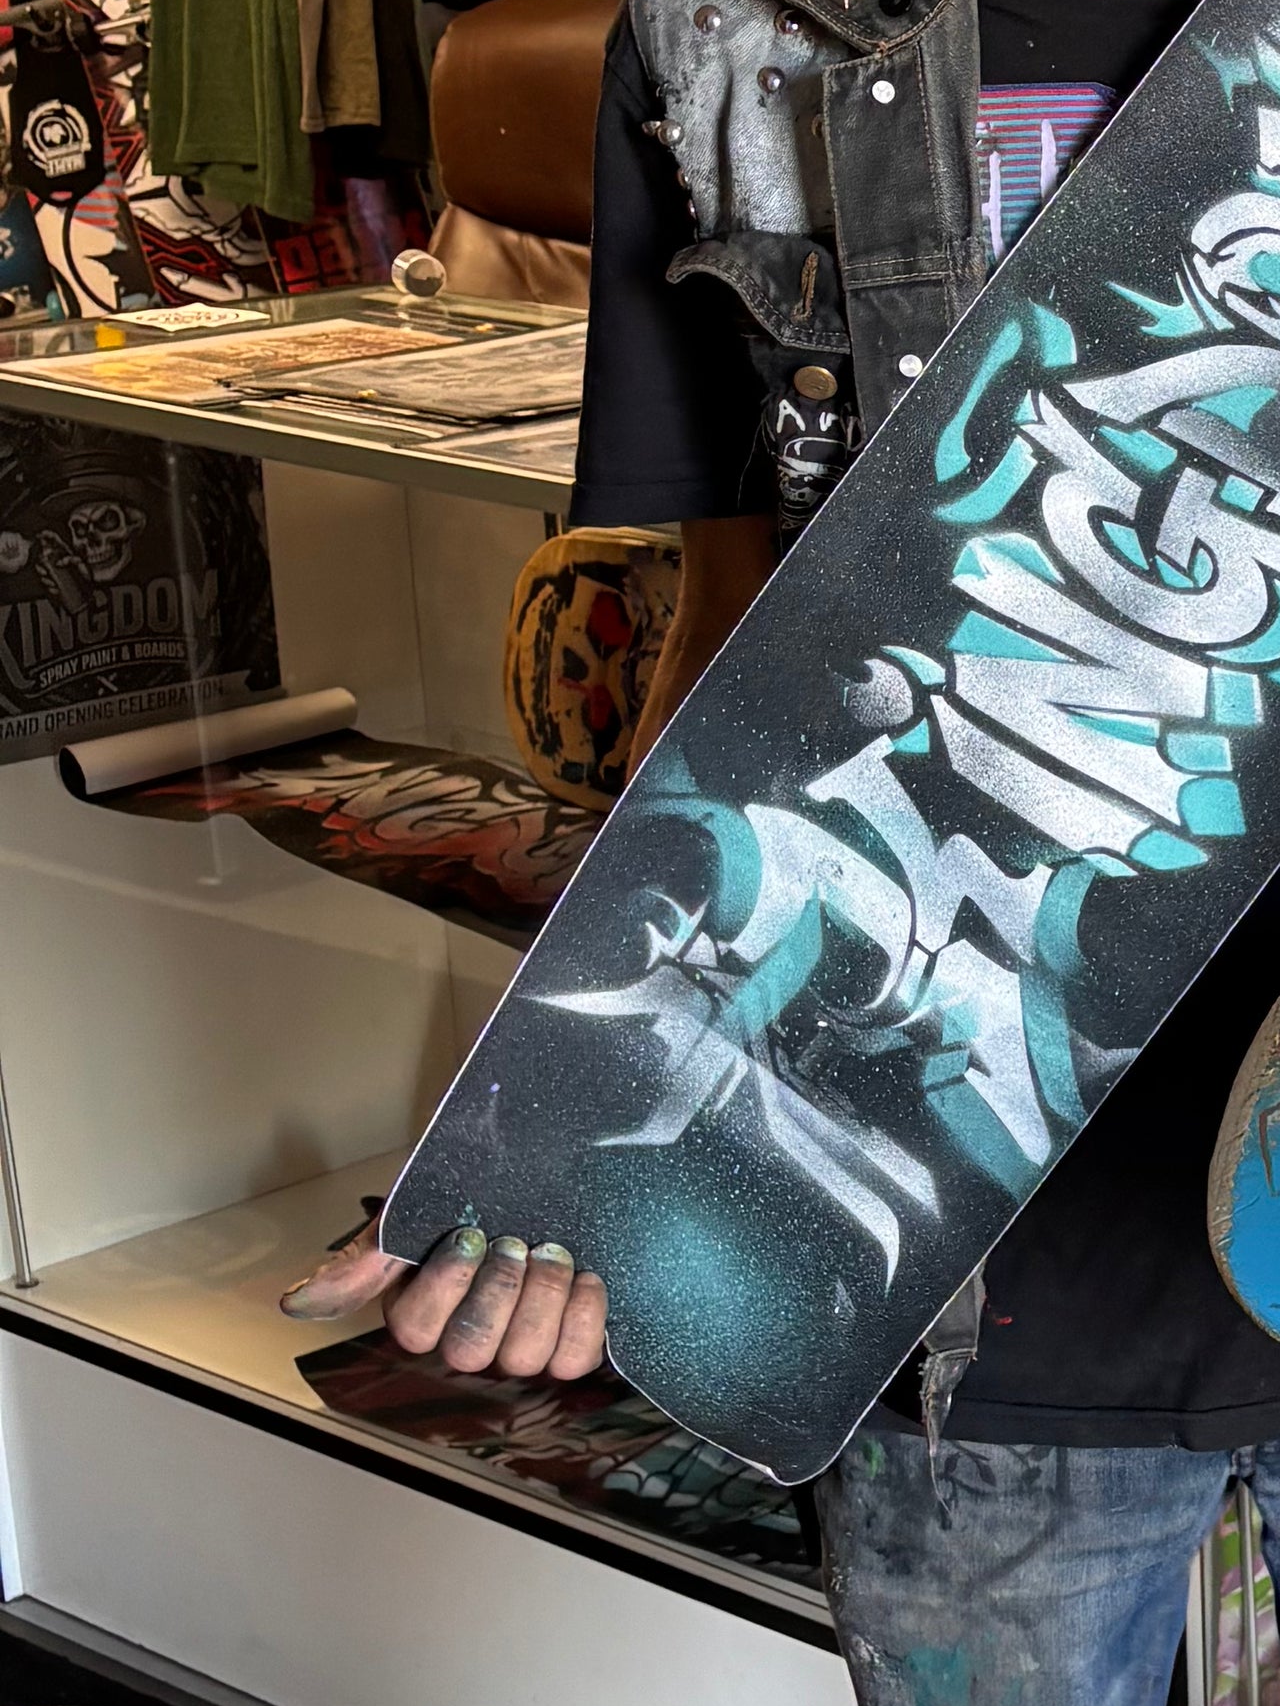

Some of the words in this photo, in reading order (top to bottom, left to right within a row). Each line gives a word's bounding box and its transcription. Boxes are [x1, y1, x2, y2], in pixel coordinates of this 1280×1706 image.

[39, 658, 78, 689] SPRAY
[81, 645, 117, 673] PAINT
[134, 642, 185, 660] BOARDS
[44, 699, 115, 731] OPENING
